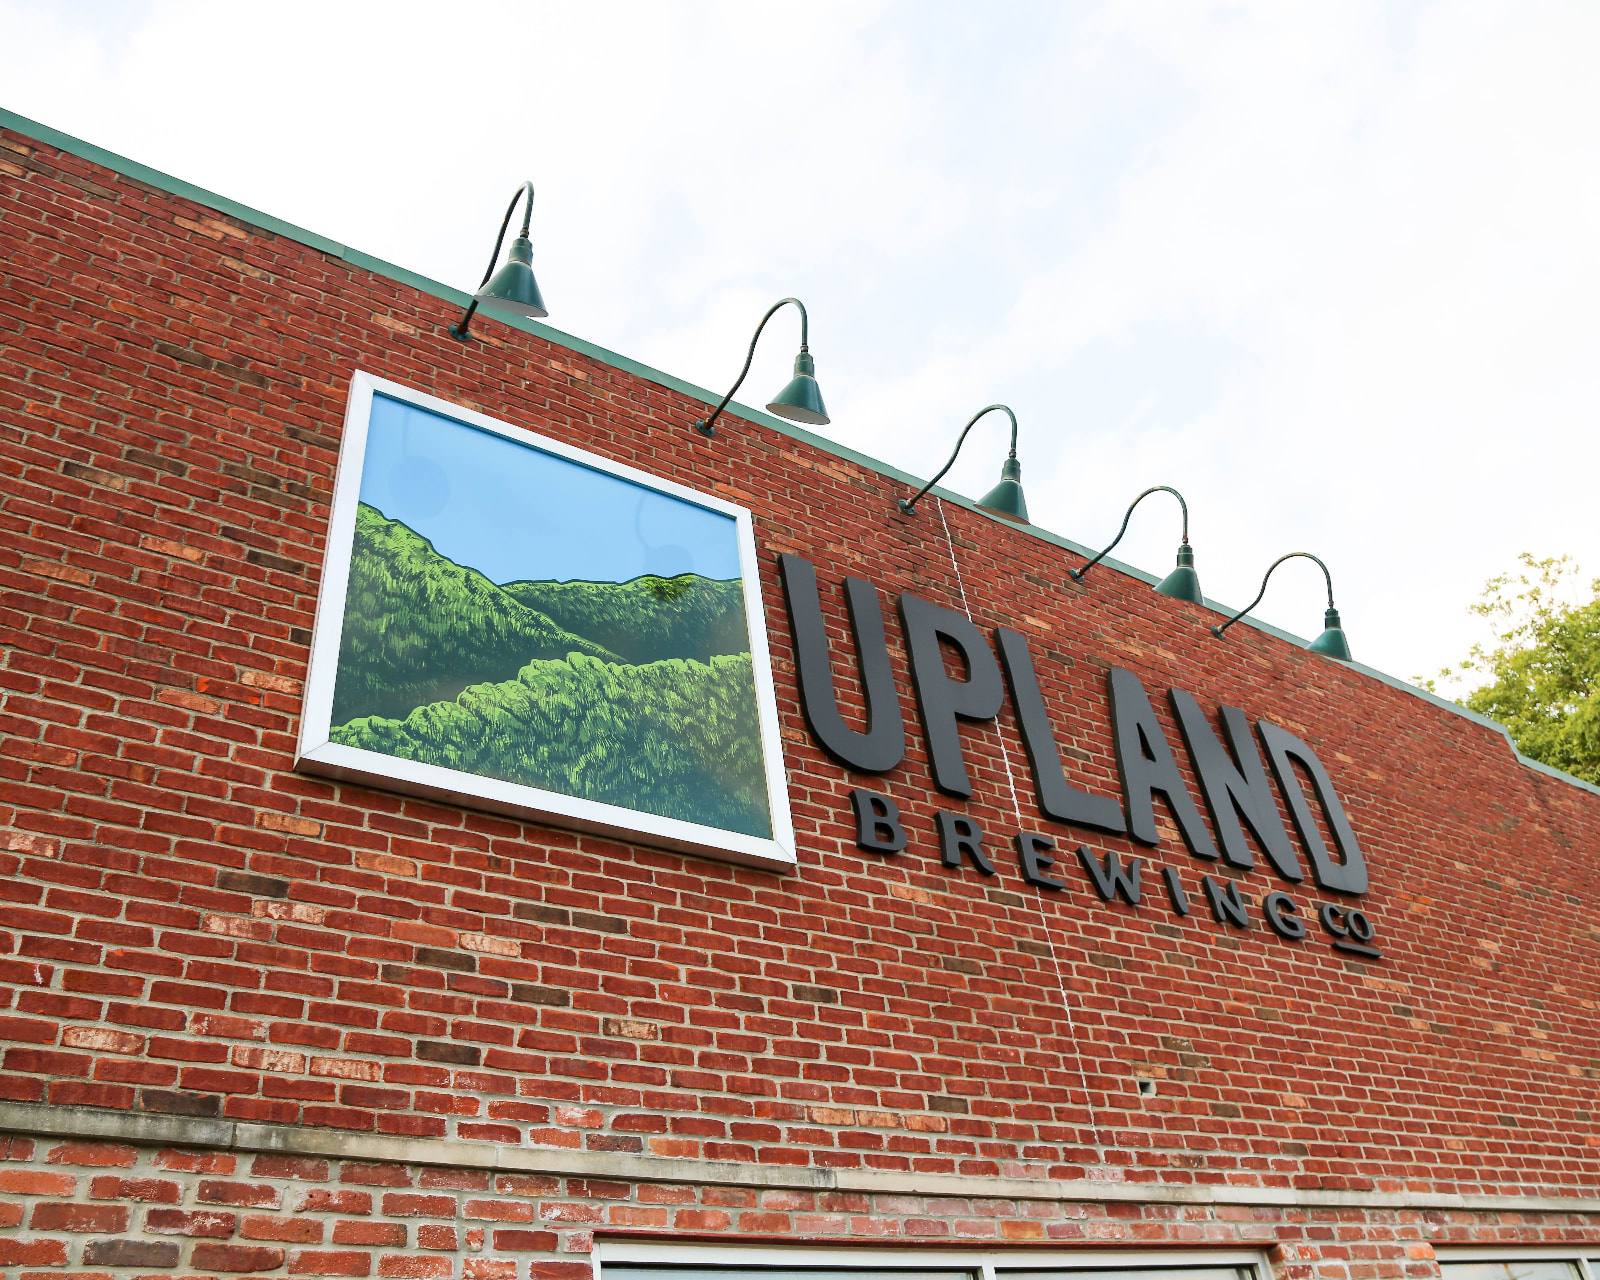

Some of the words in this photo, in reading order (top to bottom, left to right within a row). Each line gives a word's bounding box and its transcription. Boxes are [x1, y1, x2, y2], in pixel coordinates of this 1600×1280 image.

[780, 553, 1368, 896] UPLAND
[850, 789, 1306, 940] BREWING
[1319, 903, 1375, 943] CO
